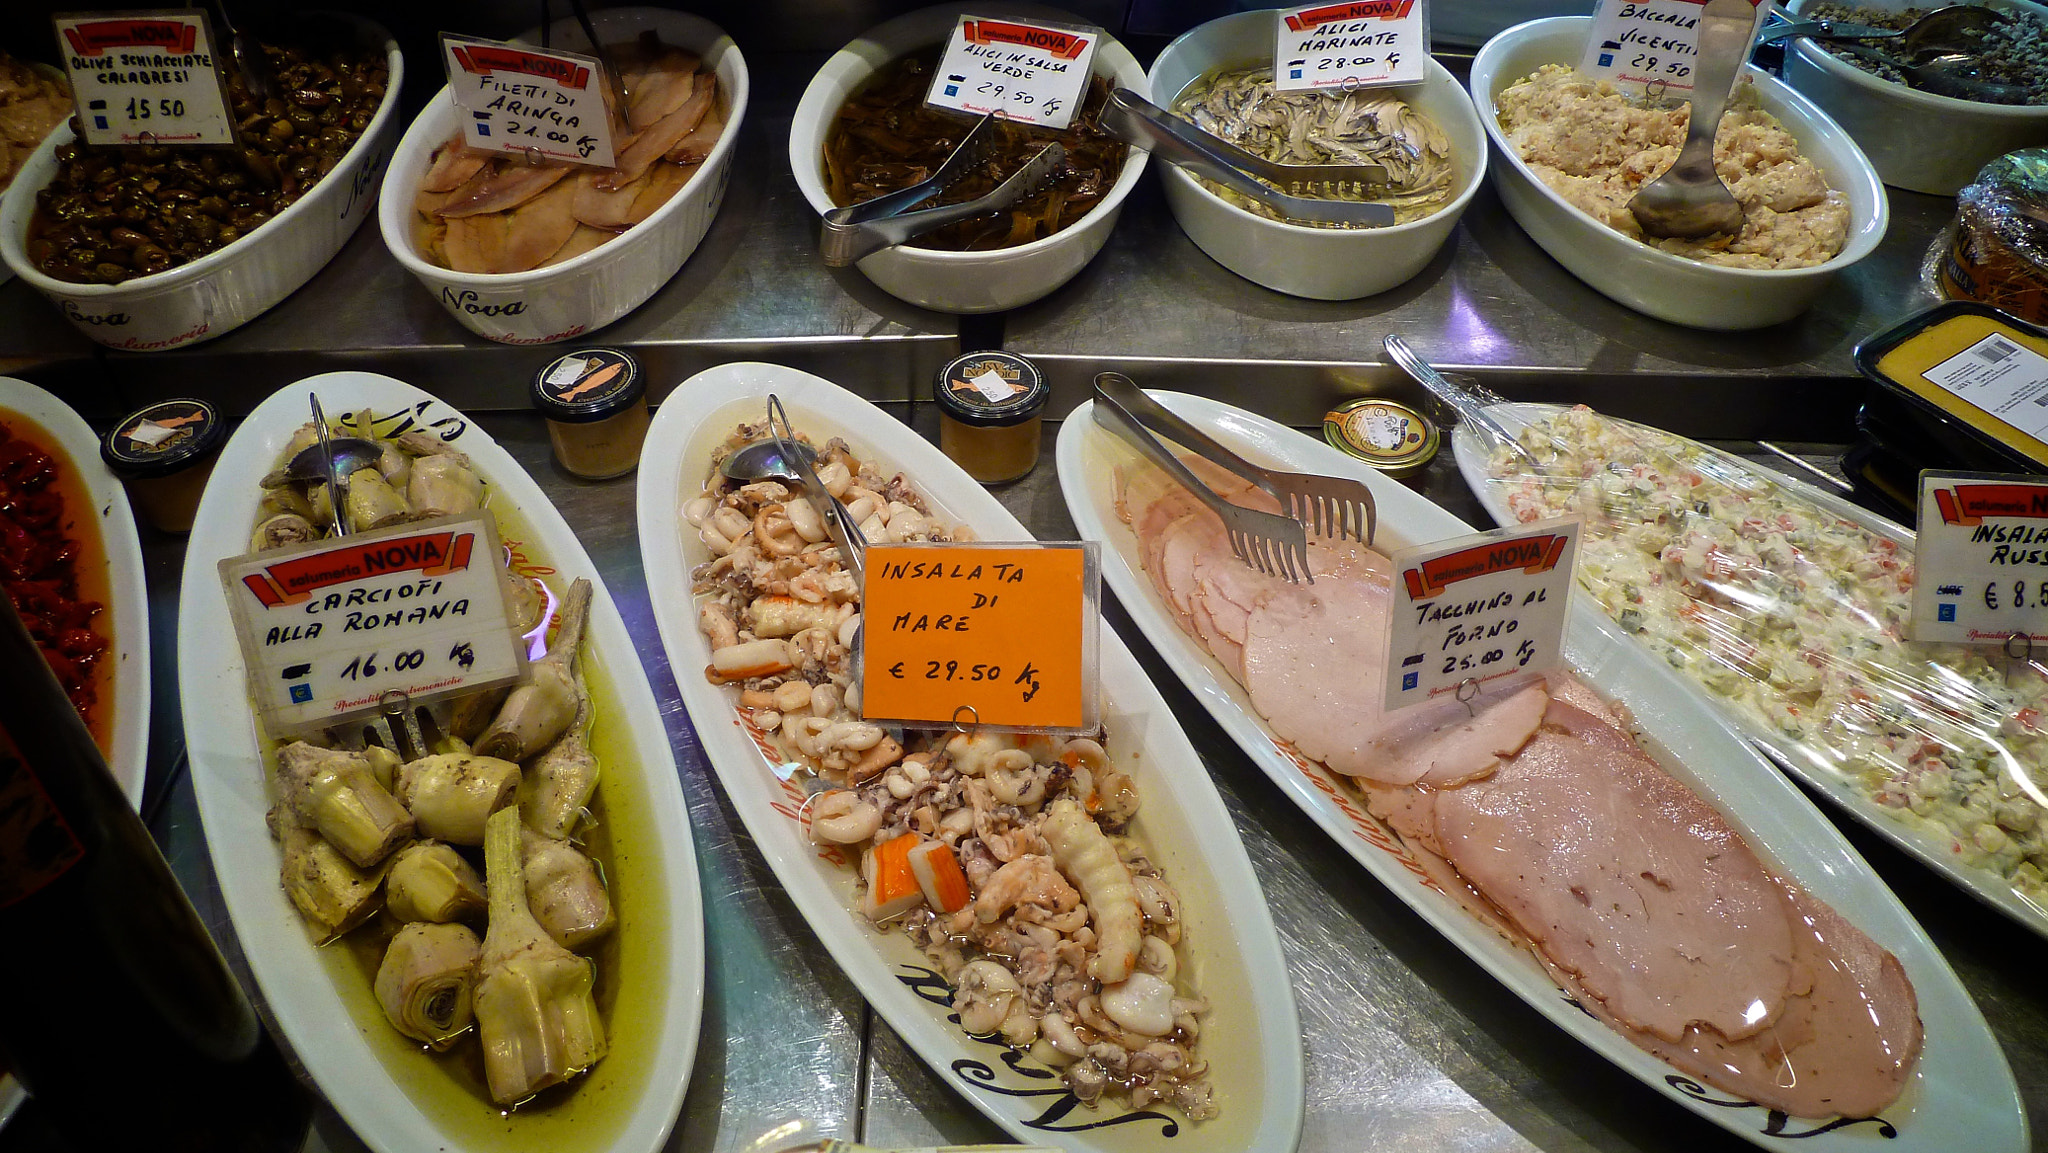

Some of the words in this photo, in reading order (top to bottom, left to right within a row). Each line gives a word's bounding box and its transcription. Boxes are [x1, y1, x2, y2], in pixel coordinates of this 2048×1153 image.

[1307, 12, 1347, 23] salumeria
[1350, 2, 1394, 17] NOVA
[982, 29, 1022, 42] salumeria
[1024, 31, 1067, 50] NOVA
[1298, 32, 1398, 52] MARINATE
[1313, 22, 1368, 36] ALICI
[1620, 28, 1699, 56] VICENTI
[71, 55, 114, 70] OLIVE
[120, 54, 213, 69] SCHIACCIATE
[522, 57, 570, 78] NOVA
[963, 44, 1003, 60] ALICI
[1006, 52, 1026, 63] IN
[1025, 57, 1069, 73] SALSA
[983, 61, 1035, 80] VERDE
[1631, 53, 1691, 77] 29.50
[97, 70, 190, 85] CALABRESI
[480, 75, 548, 99] FILETTI
[554, 92, 575, 107] DI
[486, 95, 580, 128] ARINGA
[977, 81, 1035, 105] 29.50
[1042, 97, 1063, 117] Kg
[506, 121, 570, 144] 21.00
[576, 135, 599, 158] Kg
[442, 286, 528, 317] Nova
[1969, 500, 2027, 513] salumeria
[288, 564, 361, 588] salumeria
[363, 540, 442, 573] NOVA
[880, 560, 1025, 584] INSALATA
[1432, 562, 1485, 583] salumeria
[1487, 541, 1542, 570] NOVA
[305, 579, 443, 615] CARCIOFI
[970, 592, 999, 610] DI
[1416, 590, 1513, 625] TACCHINO
[1522, 587, 1547, 607] AL
[1984, 581, 2000, 611] €
[265, 621, 324, 647] ALLA
[342, 598, 471, 633] ROMANA
[892, 611, 970, 633] MARE
[1441, 619, 1519, 651] FORNO
[340, 649, 425, 683] 16.00
[1442, 648, 1504, 675] 25.00
[1515, 639, 1536, 667] Kg
[888, 661, 905, 679] €
[924, 659, 1002, 682] 29.50
[1014, 661, 1040, 703] Kg
